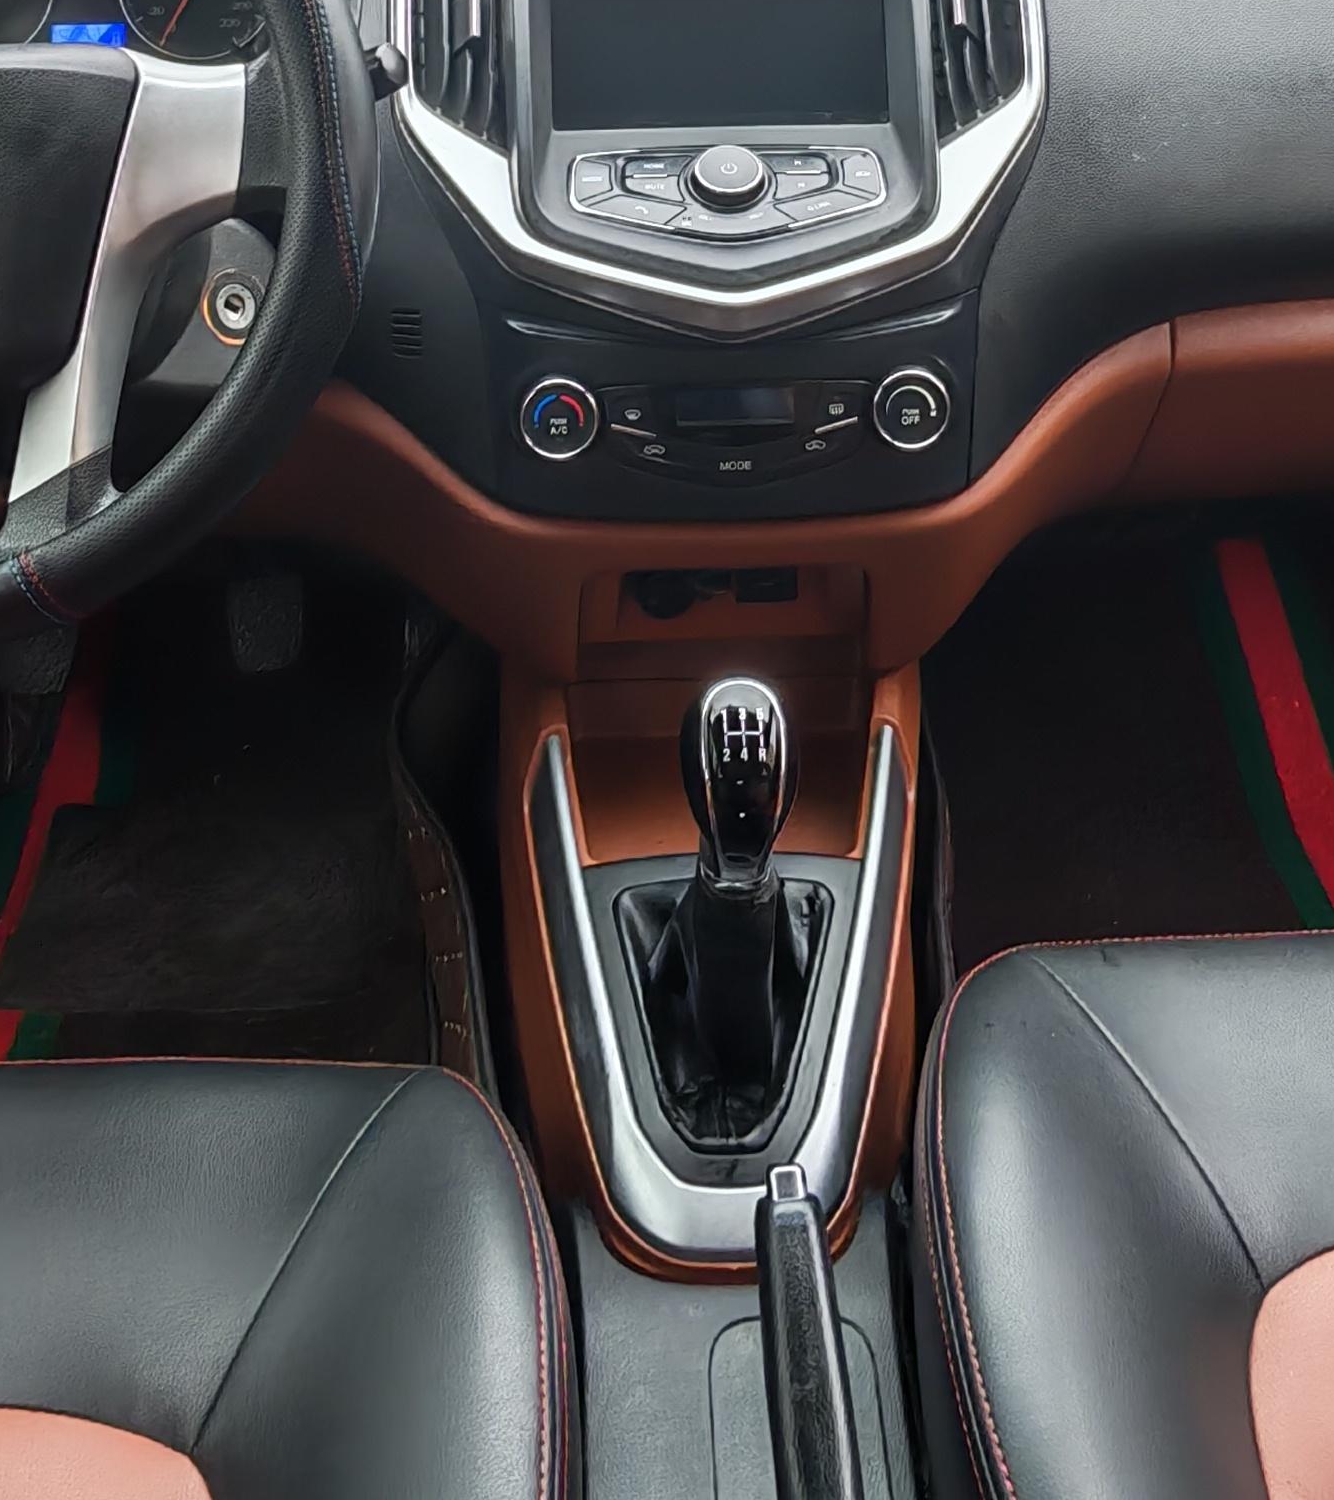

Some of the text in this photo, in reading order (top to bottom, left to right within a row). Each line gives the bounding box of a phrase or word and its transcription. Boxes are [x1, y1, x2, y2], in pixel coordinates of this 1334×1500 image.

[148, 6, 165, 16] 20
[900, 415, 921, 426] OFF
[550, 426, 568, 435] A/C
[719, 460, 752, 471] MODE
[738, 707, 747, 721] 3
[755, 707, 764, 721] 5
[723, 747, 767, 762] 2 4 R
